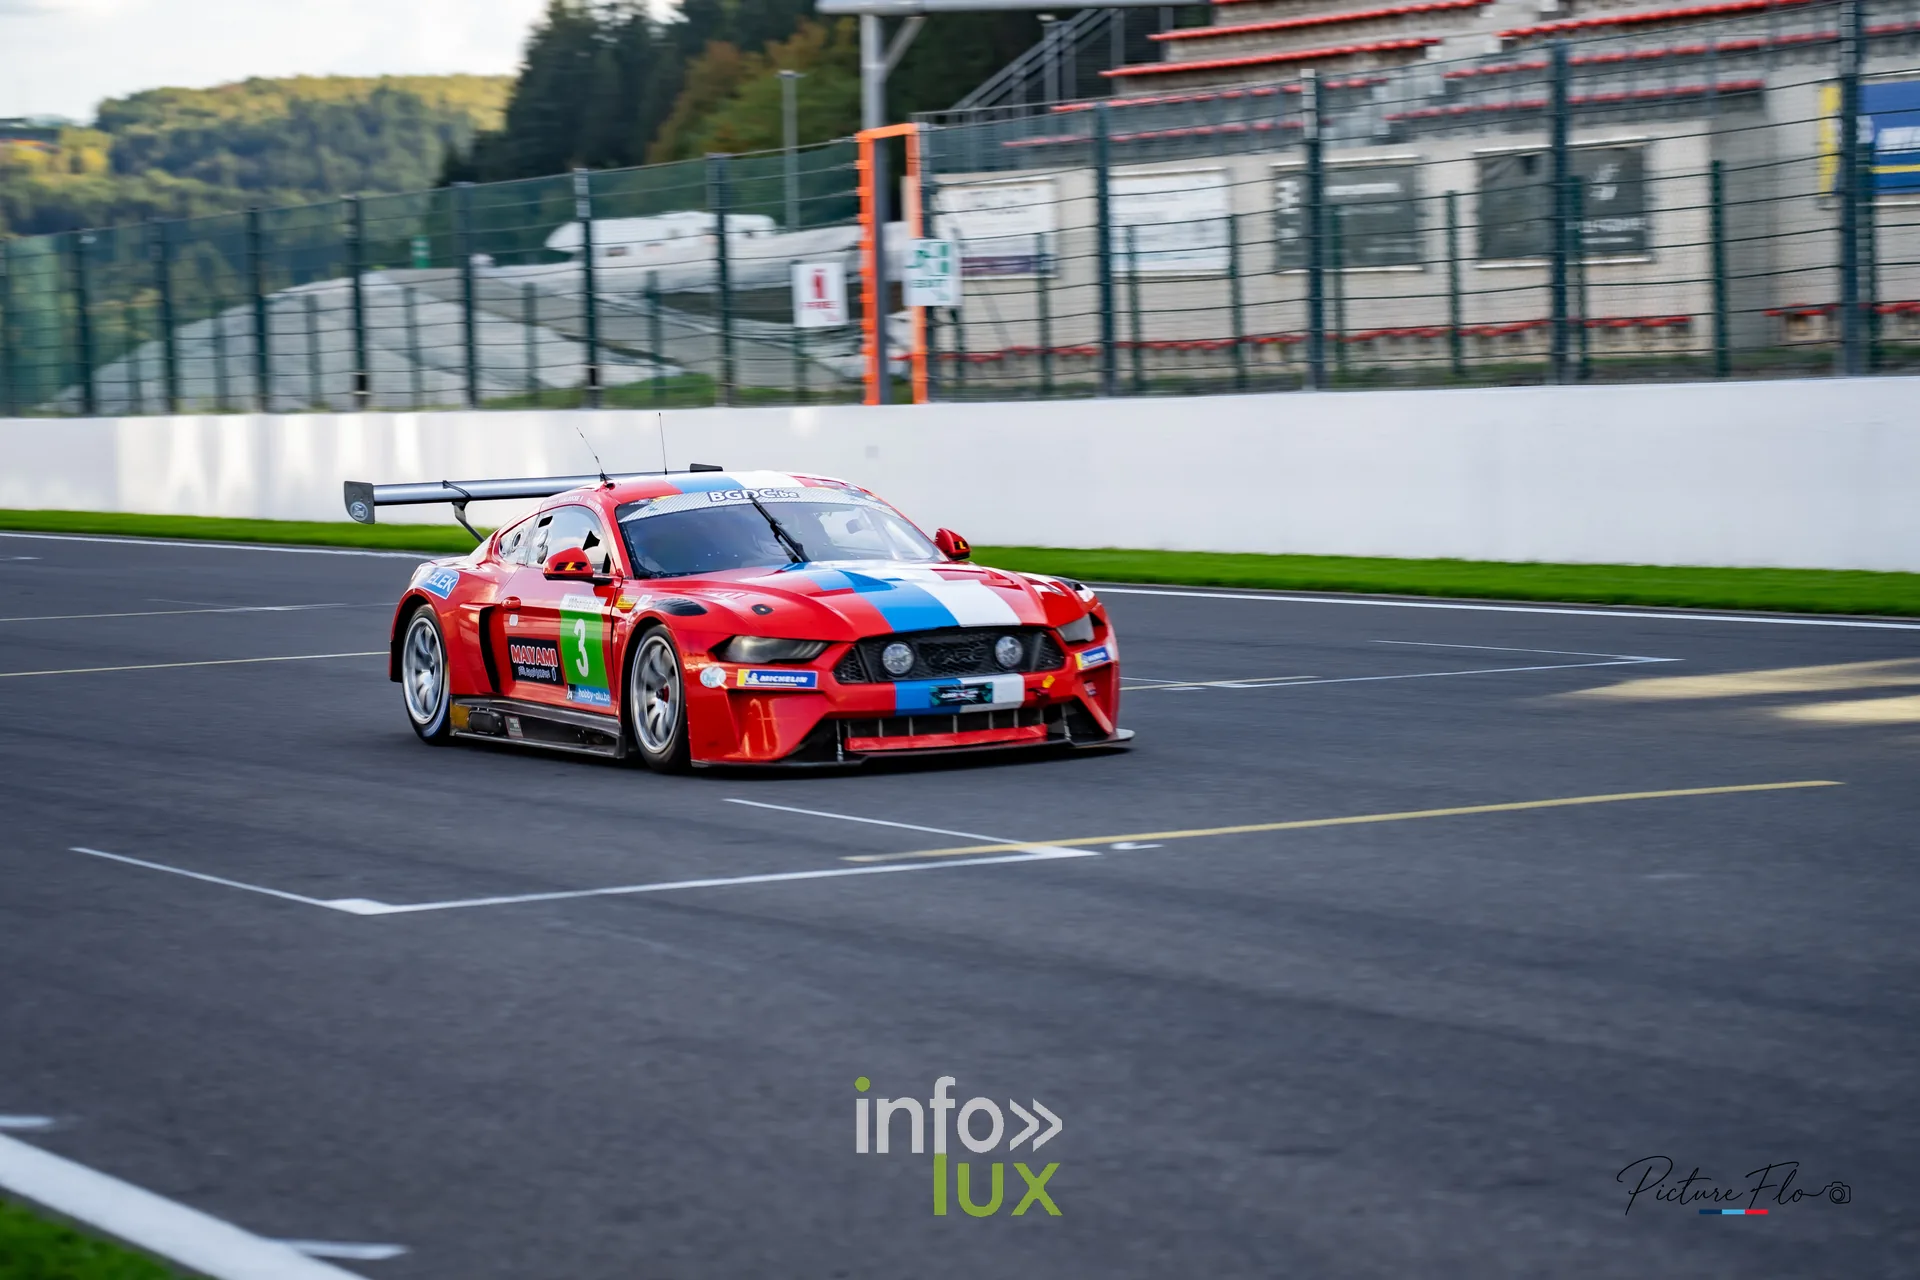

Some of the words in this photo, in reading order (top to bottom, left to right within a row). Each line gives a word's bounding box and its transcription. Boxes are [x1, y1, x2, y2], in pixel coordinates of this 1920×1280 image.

[707, 488, 800, 502] BGDC.be
[554, 562, 588, 572] ELR
[573, 618, 589, 678] 3
[760, 674, 808, 684] MICHELIN
[578, 687, 611, 702] hobby-alu.be
